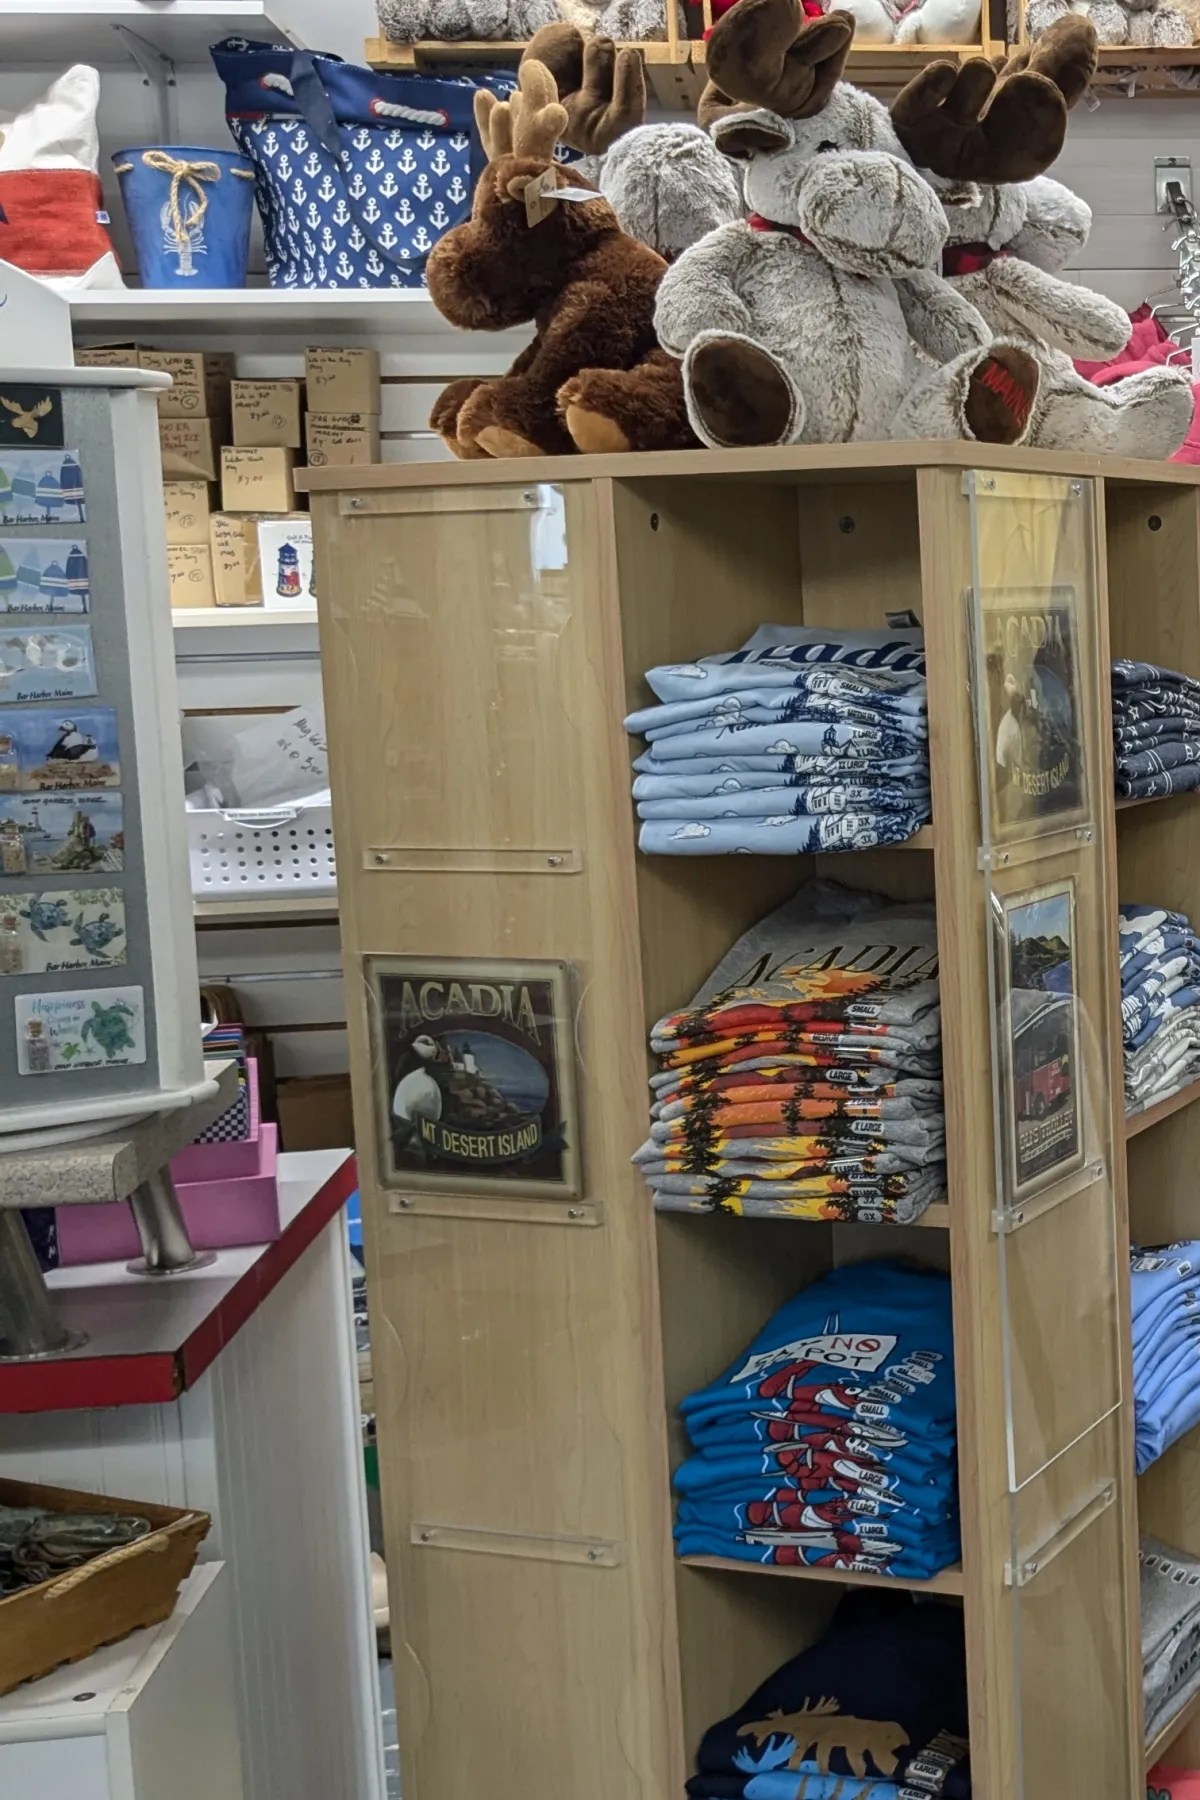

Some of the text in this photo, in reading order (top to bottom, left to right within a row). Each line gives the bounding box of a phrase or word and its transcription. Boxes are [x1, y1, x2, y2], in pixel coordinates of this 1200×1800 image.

[841, 681, 864, 693] SMALL
[17, 692, 29, 700] Bar
[1023, 769, 1050, 796] DESERT
[1050, 752, 1069, 788] ISLAND
[850, 789, 862, 798] 3X
[858, 816, 870, 826] 3X
[861, 834, 873, 844] 3X
[398, 981, 542, 1046] ACADIA
[852, 1005, 876, 1014] SMALL
[829, 1070, 853, 1081] LARGE
[855, 1122, 882, 1132] X LARGE
[443, 1132, 495, 1158] DESERT
[498, 1123, 538, 1156] ISLAND
[864, 1212, 876, 1221] 3X
[805, 1347, 872, 1367] POT
[861, 1404, 884, 1415] SMALL
[859, 1470, 884, 1485] LARGE
[856, 1502, 876, 1514] LARGE
[865, 1527, 885, 1535] LARGE
[914, 1762, 939, 1776] LARGE
[902, 1789, 927, 1799] LARGE
